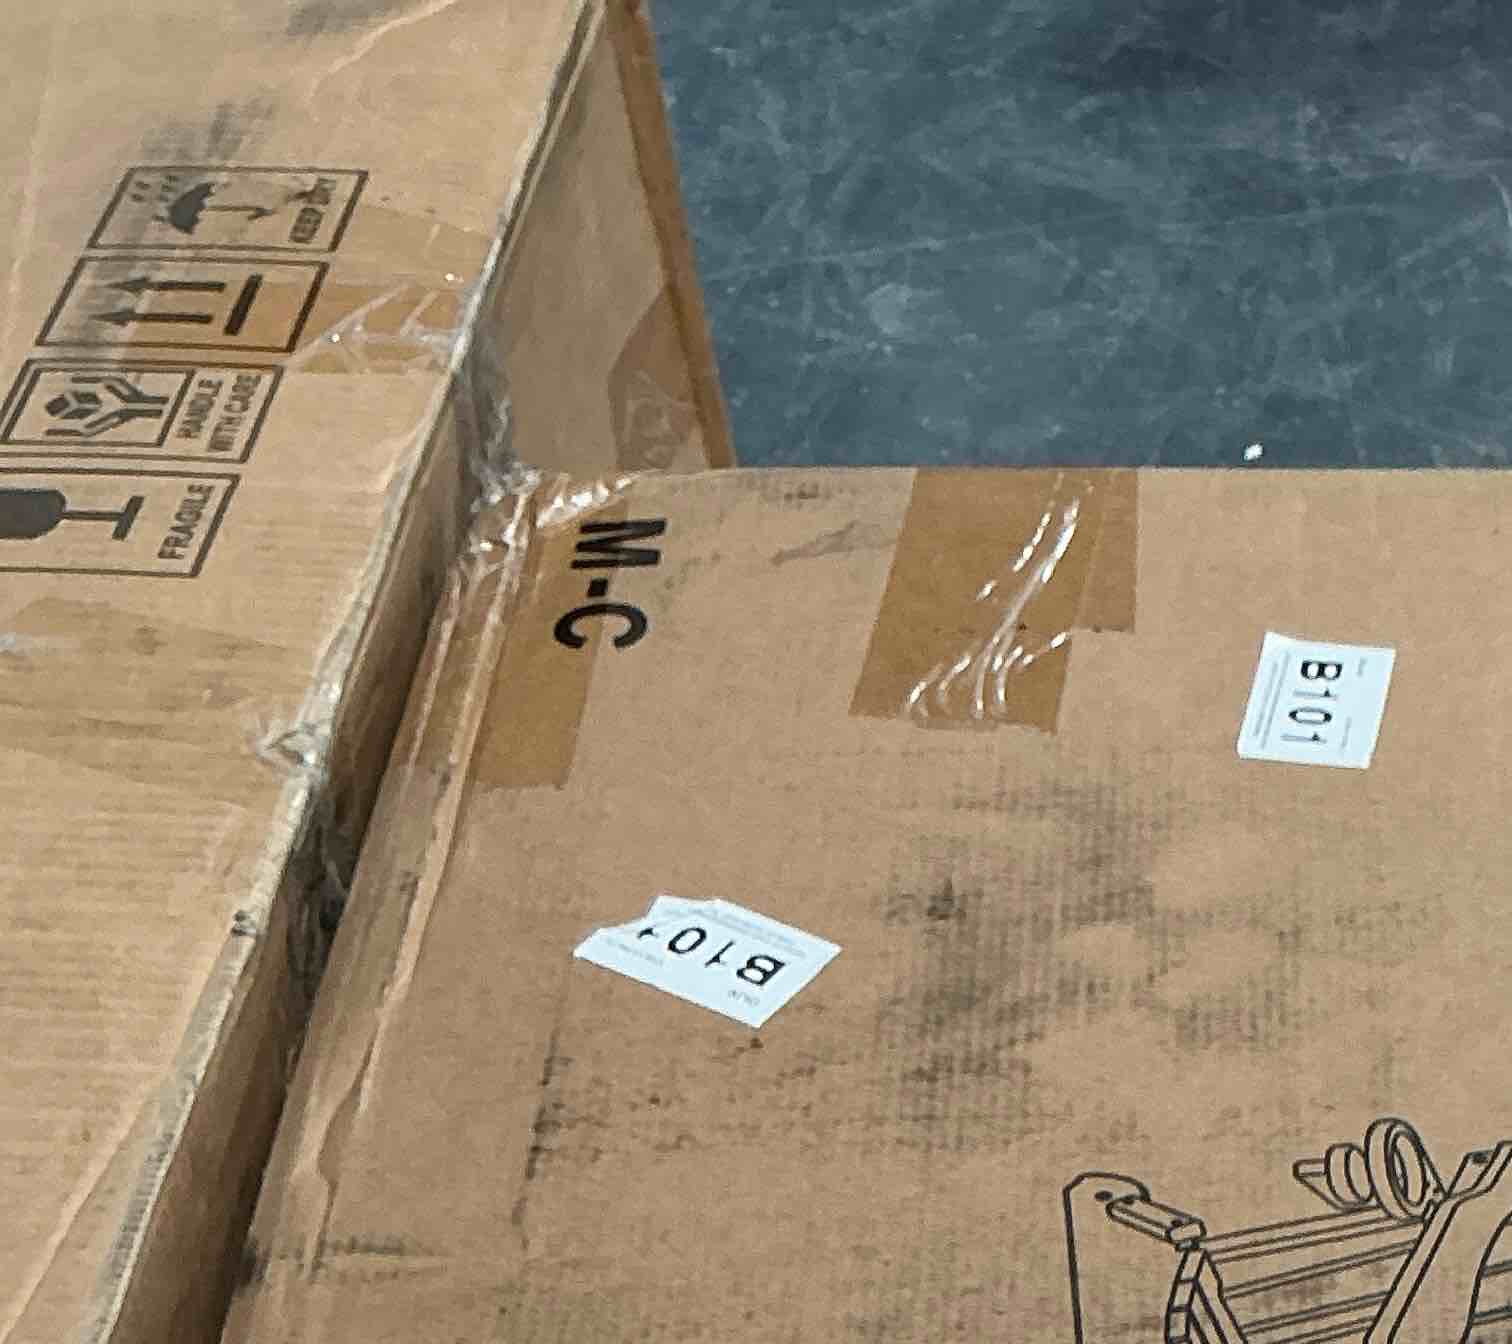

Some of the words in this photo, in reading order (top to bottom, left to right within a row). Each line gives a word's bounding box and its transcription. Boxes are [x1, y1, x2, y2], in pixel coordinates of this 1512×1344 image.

[177, 379, 222, 439] HANDLE
[207, 415, 241, 452] WITH
[225, 375, 260, 413] CARE
[158, 485, 214, 560] FRAGILE
[554, 517, 667, 650] M-C
[1281, 660, 1343, 745] B101
